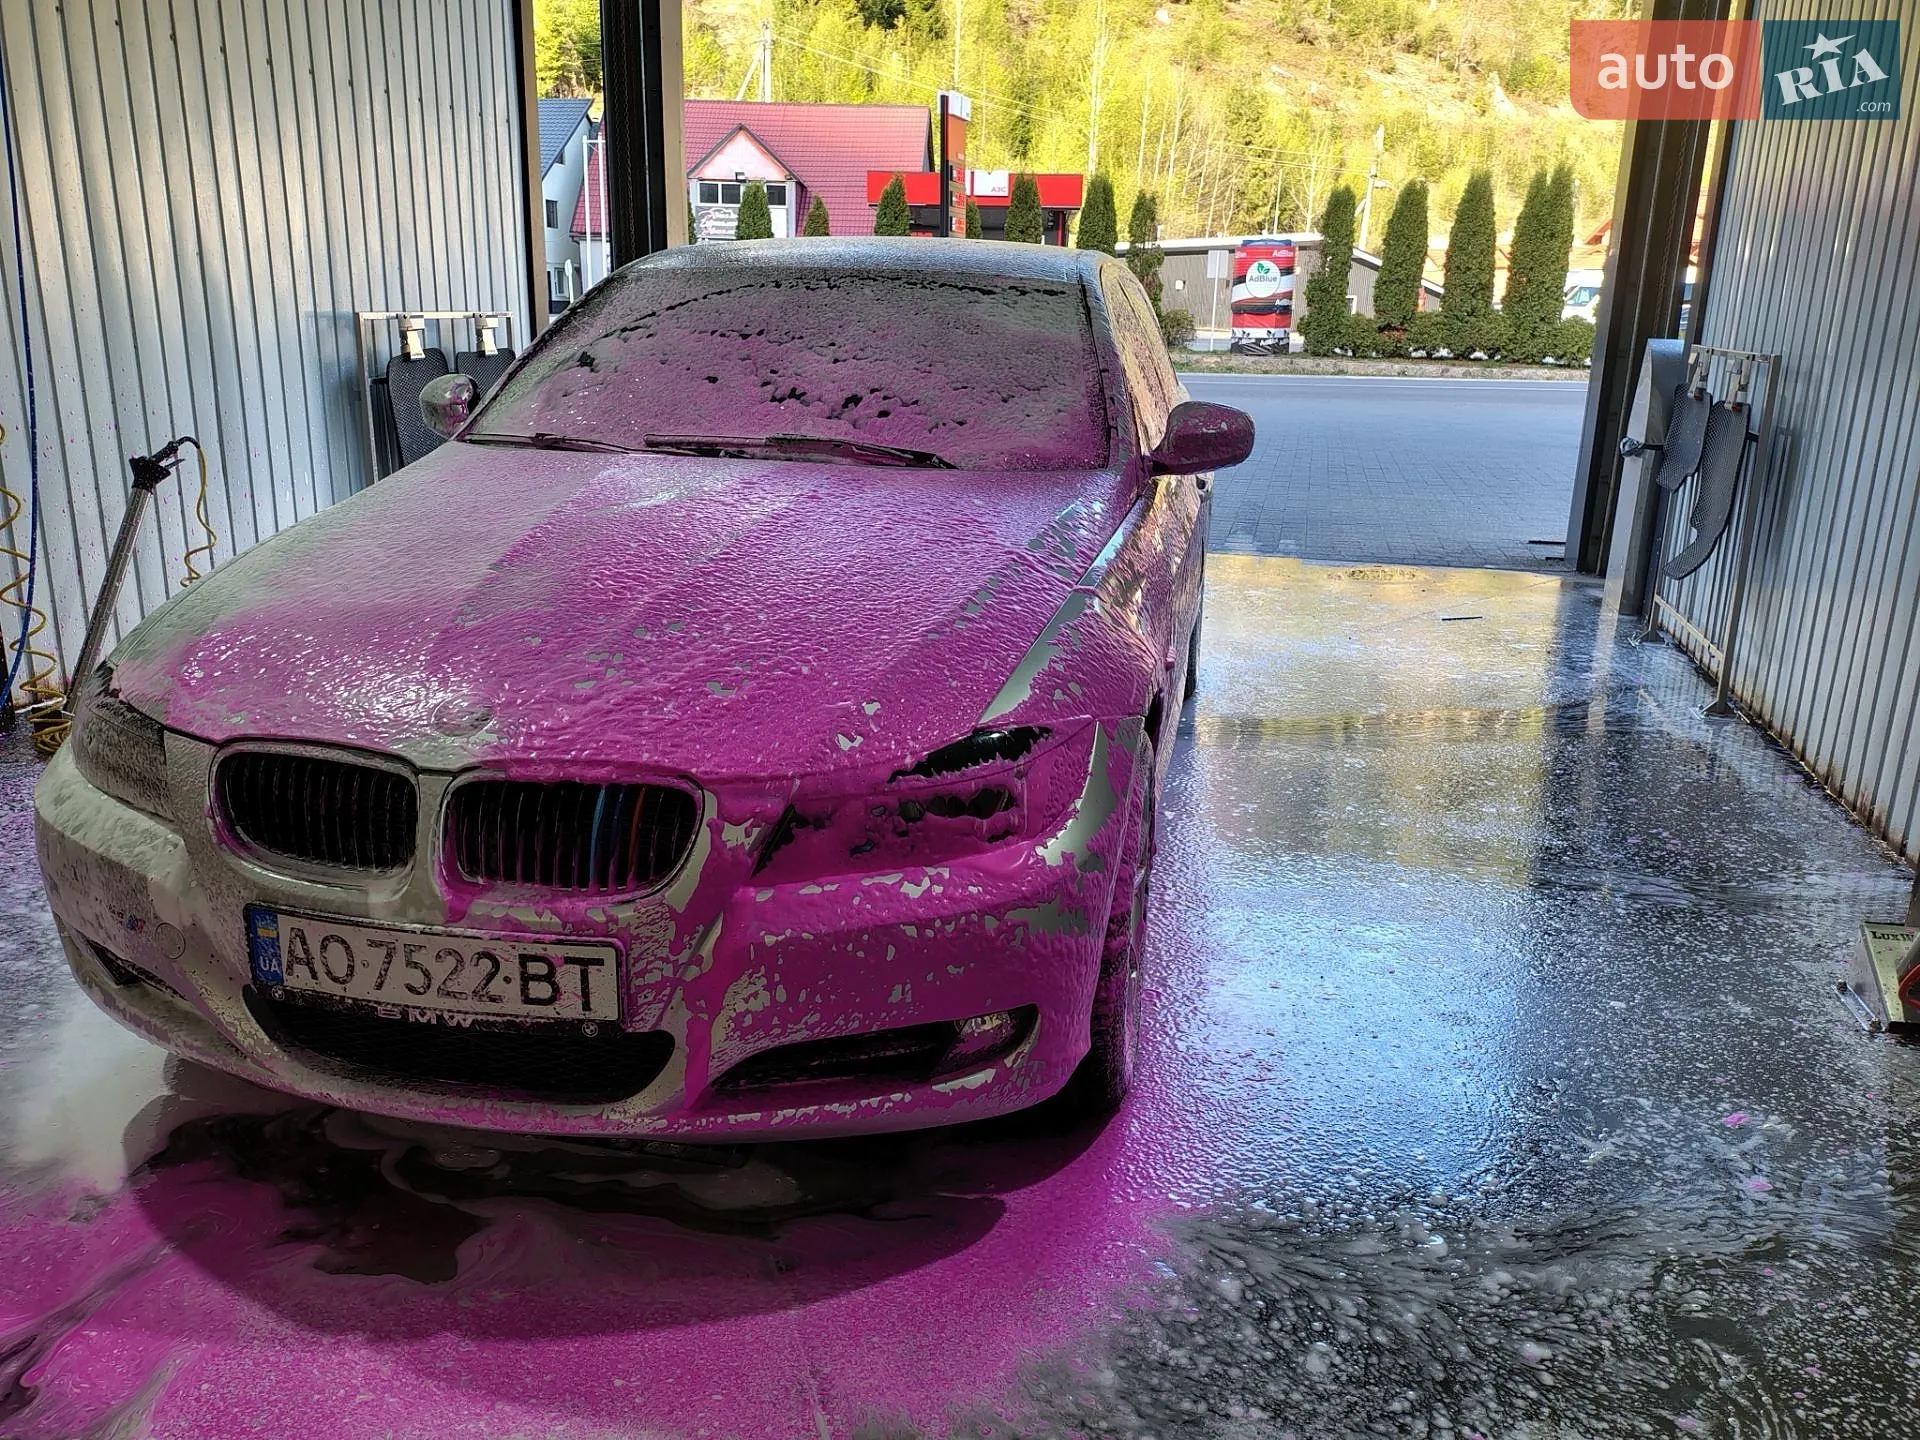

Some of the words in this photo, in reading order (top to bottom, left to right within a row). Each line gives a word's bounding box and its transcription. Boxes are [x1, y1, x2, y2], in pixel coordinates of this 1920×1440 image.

[1248, 275, 1278, 283] AdBlue
[260, 956, 280, 973] UA
[285, 927, 355, 985] AO
[366, 939, 505, 1004] 7522
[518, 953, 605, 1012] BT
[377, 1005, 474, 1028] BMW
